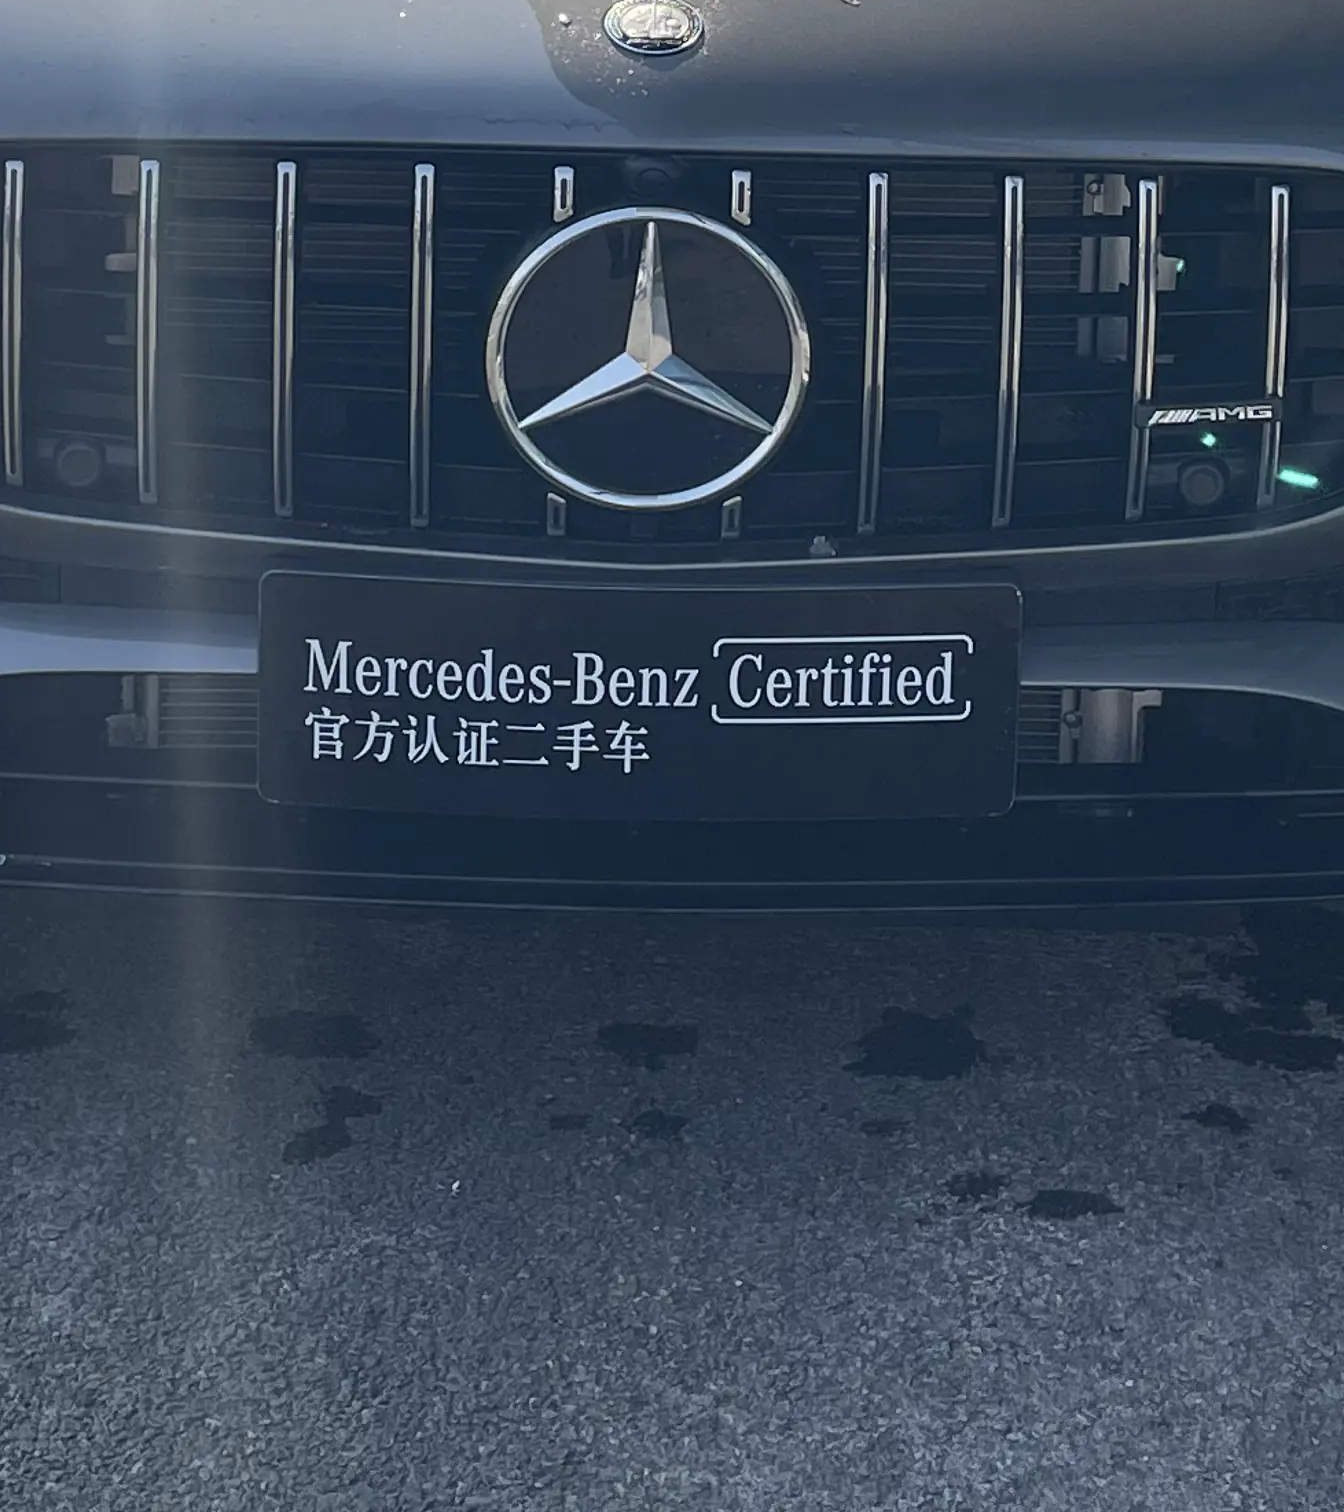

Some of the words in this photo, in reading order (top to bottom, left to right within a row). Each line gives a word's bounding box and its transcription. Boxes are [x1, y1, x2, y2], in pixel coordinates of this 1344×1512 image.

[1188, 404, 1273, 423] AMG
[302, 637, 700, 709] Mercedes-Benz
[728, 650, 956, 709] Certified
[303, 705, 651, 774] 官方认证二手车
